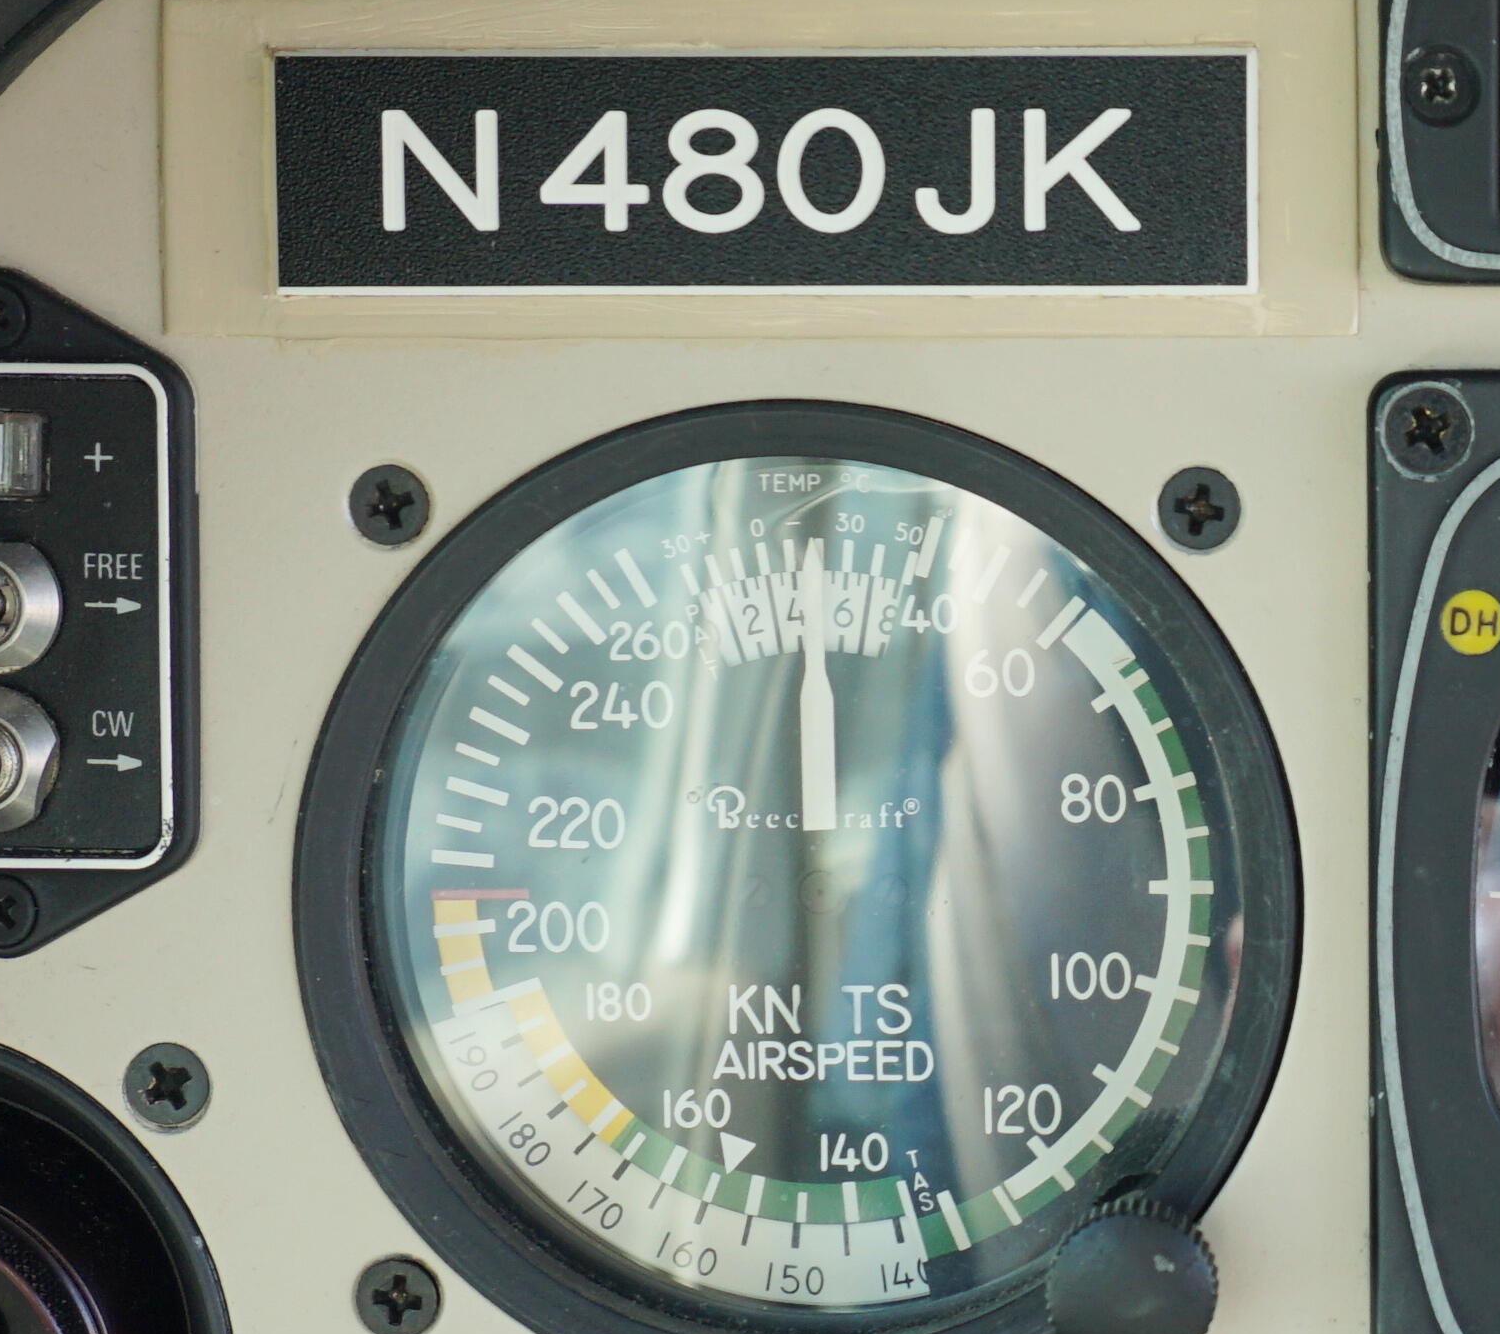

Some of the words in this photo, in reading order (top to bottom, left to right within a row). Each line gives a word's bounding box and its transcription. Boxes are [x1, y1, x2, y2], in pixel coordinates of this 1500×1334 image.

[758, 472, 822, 494] TEMP
[749, 518, 766, 539] 0
[834, 511, 866, 535] 30
[893, 522, 924, 547] 50
[83, 553, 144, 581] FREE
[741, 602, 765, 636] 2
[833, 597, 854, 628] 6
[899, 593, 960, 635] 40
[1447, 606, 1500, 637] DH
[608, 619, 691, 662] 260
[964, 648, 1036, 700] 60
[91, 710, 135, 738] CW
[568, 680, 675, 731] 240
[1059, 772, 1128, 825] 80
[526, 796, 628, 851] 220
[506, 899, 611, 956] 200
[1048, 950, 1132, 1001] 100
[583, 981, 653, 1024] 180
[447, 1028, 499, 1097] 190
[712, 1038, 936, 1083] AIRSPEED
[661, 1088, 733, 1131] 160
[982, 1083, 1063, 1136] 120
[498, 1109, 552, 1169] 180
[818, 1131, 889, 1173] 140
[567, 1177, 624, 1232] 170
[655, 1226, 719, 1279] 160
[765, 1261, 825, 1297] 150
